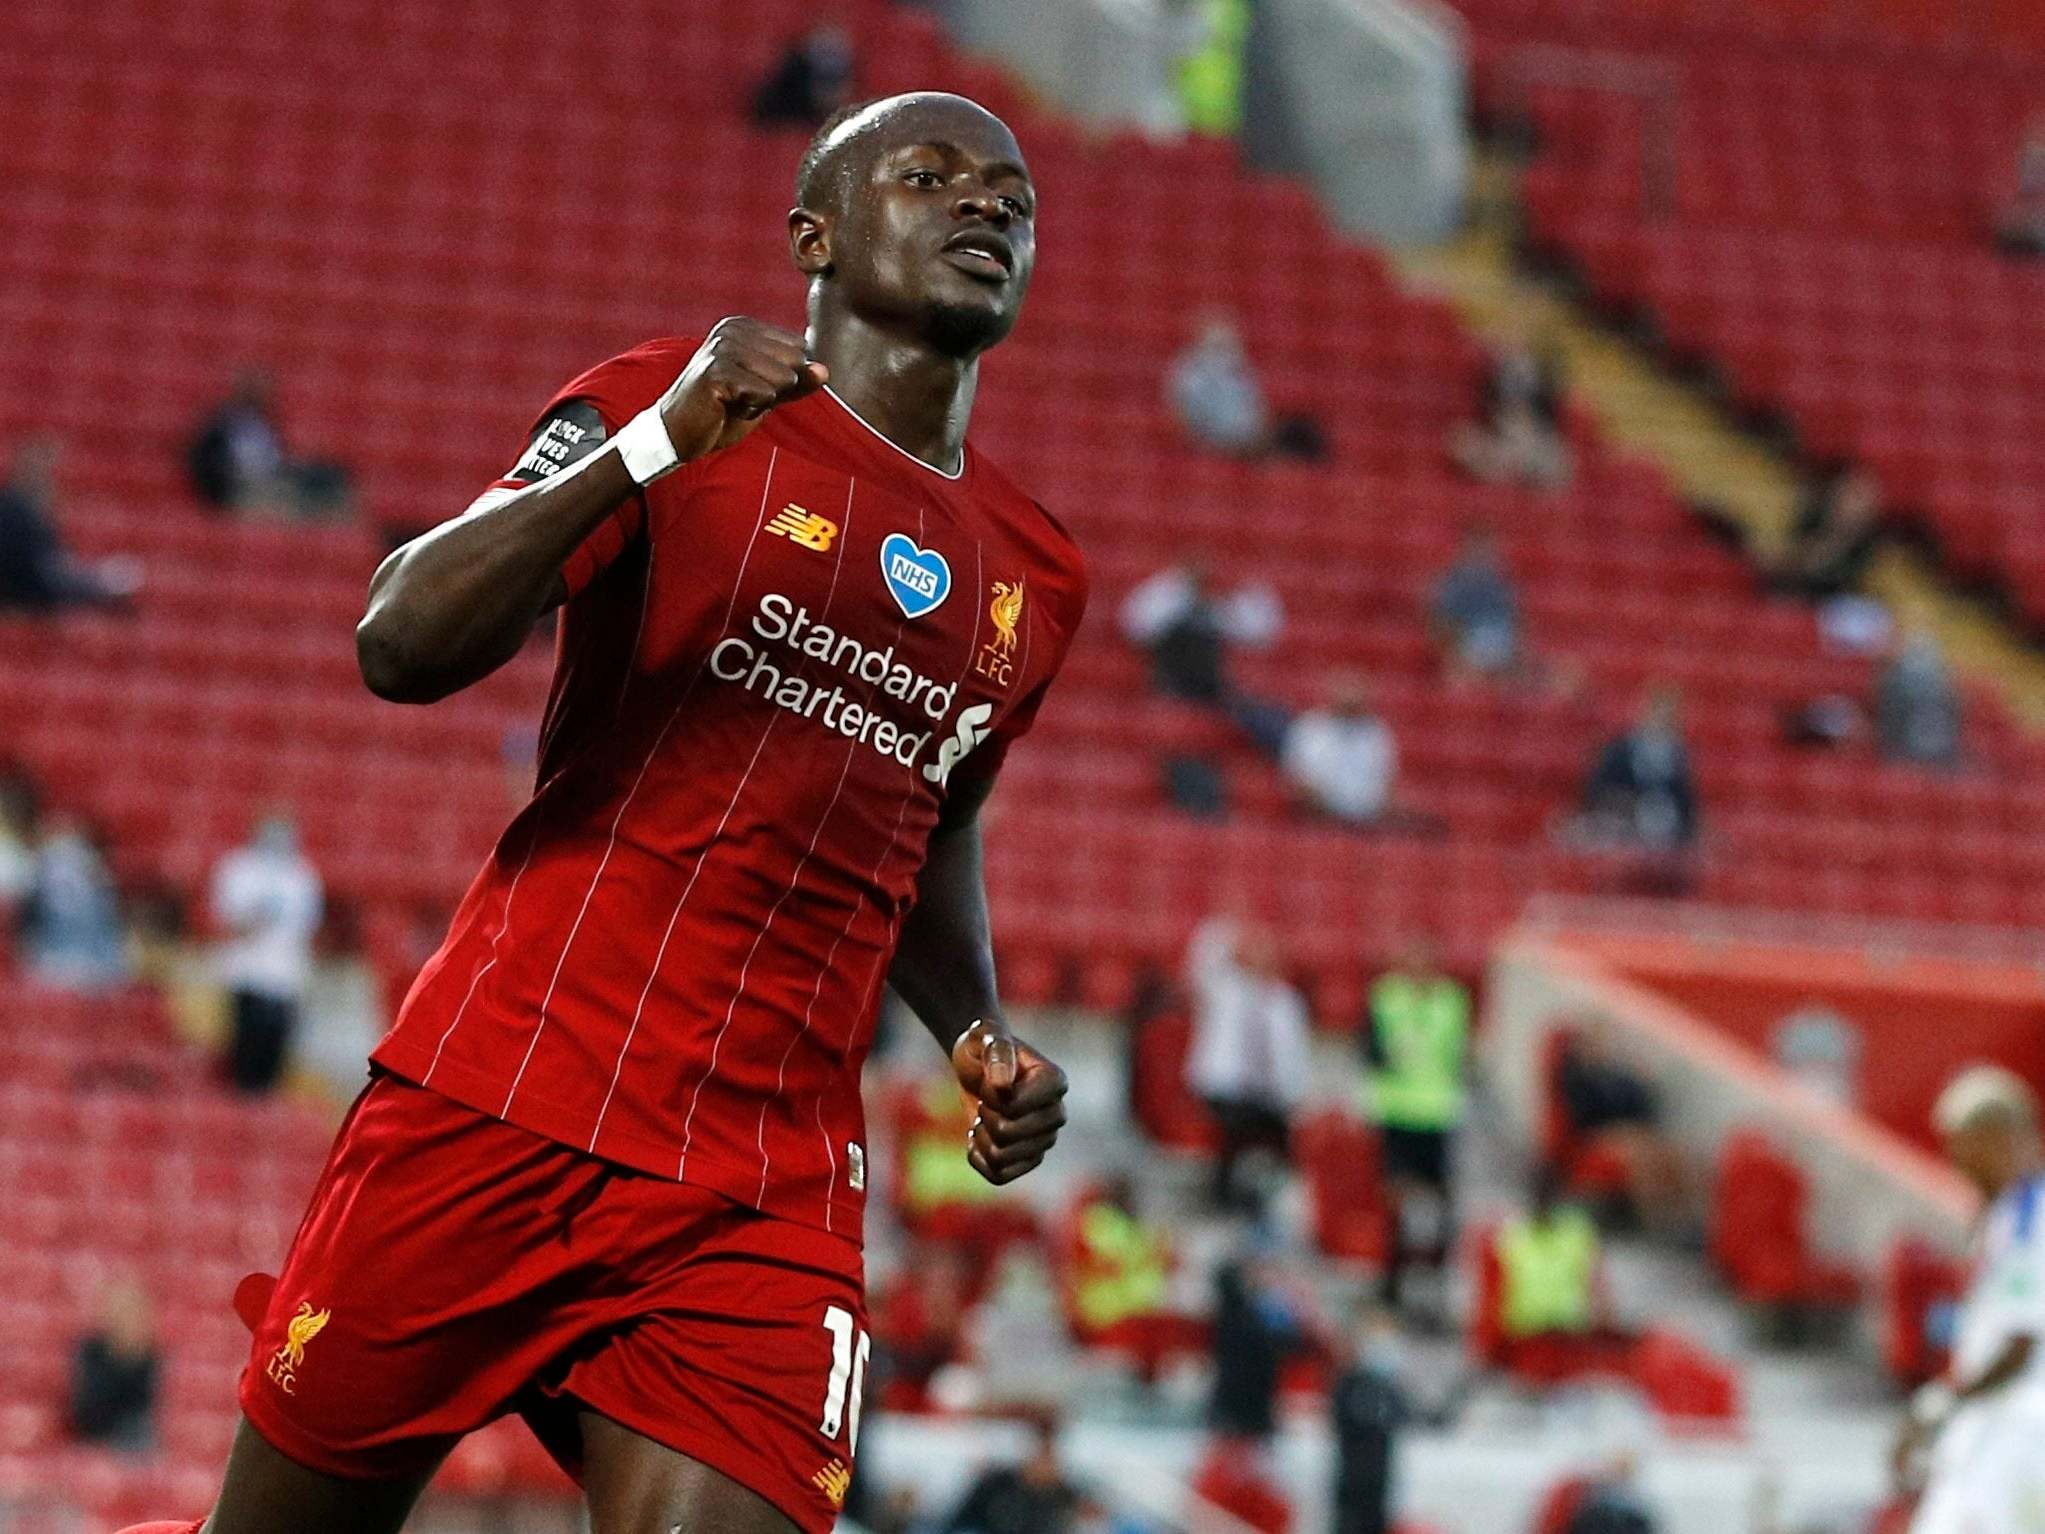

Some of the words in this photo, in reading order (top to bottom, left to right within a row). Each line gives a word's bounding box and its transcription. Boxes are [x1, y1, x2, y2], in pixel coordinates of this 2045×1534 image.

[893, 559, 935, 593] NHS
[752, 593, 958, 721] Standard
[975, 651, 1013, 687] LFC
[709, 637, 933, 768] Chartered
